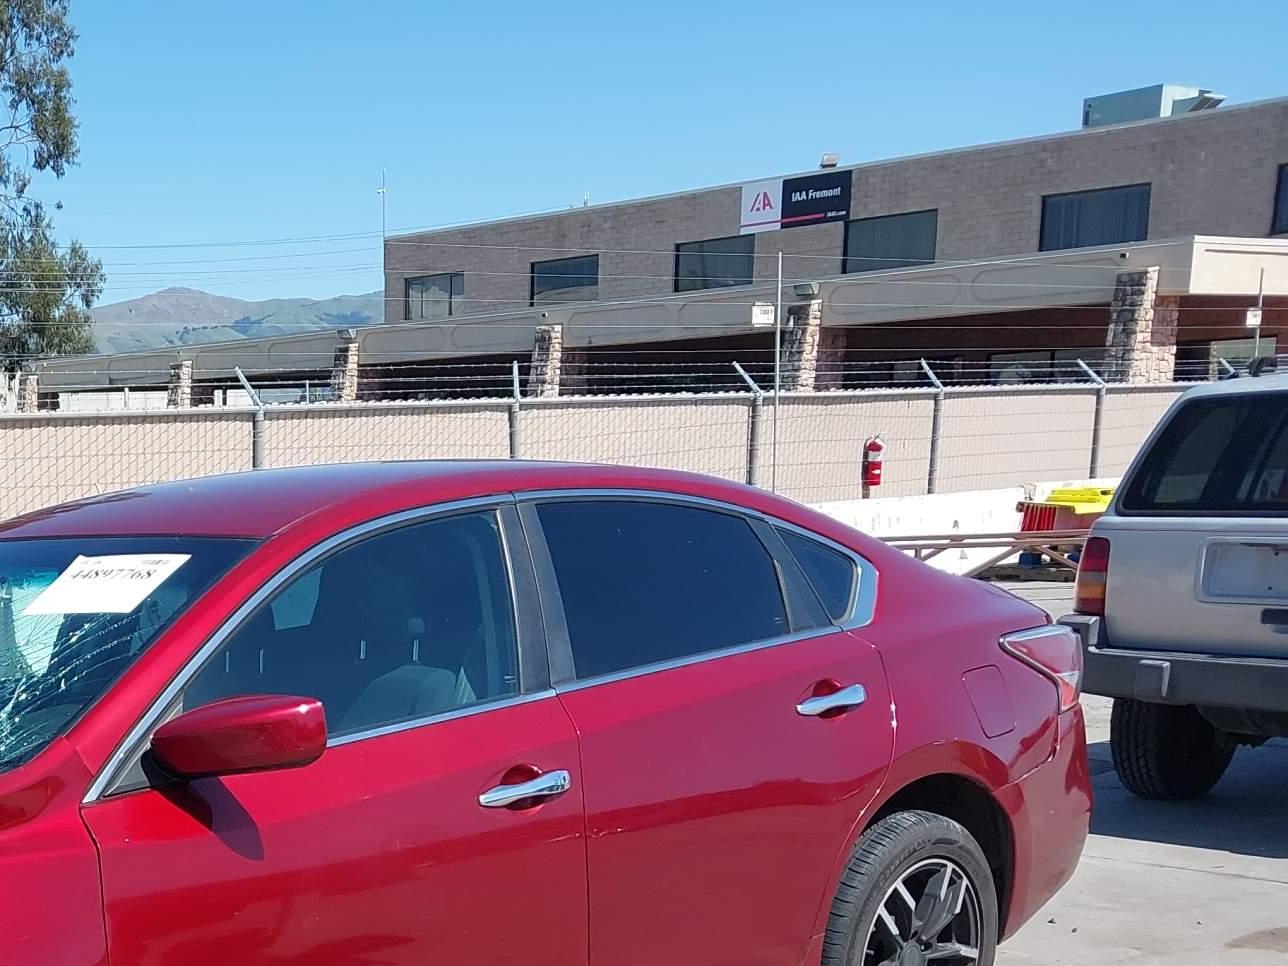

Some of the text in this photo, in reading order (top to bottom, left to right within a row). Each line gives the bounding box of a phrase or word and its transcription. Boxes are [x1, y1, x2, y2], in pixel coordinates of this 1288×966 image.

[791, 187, 842, 202] IAA Fremont
[71, 568, 158, 580] 44897768
